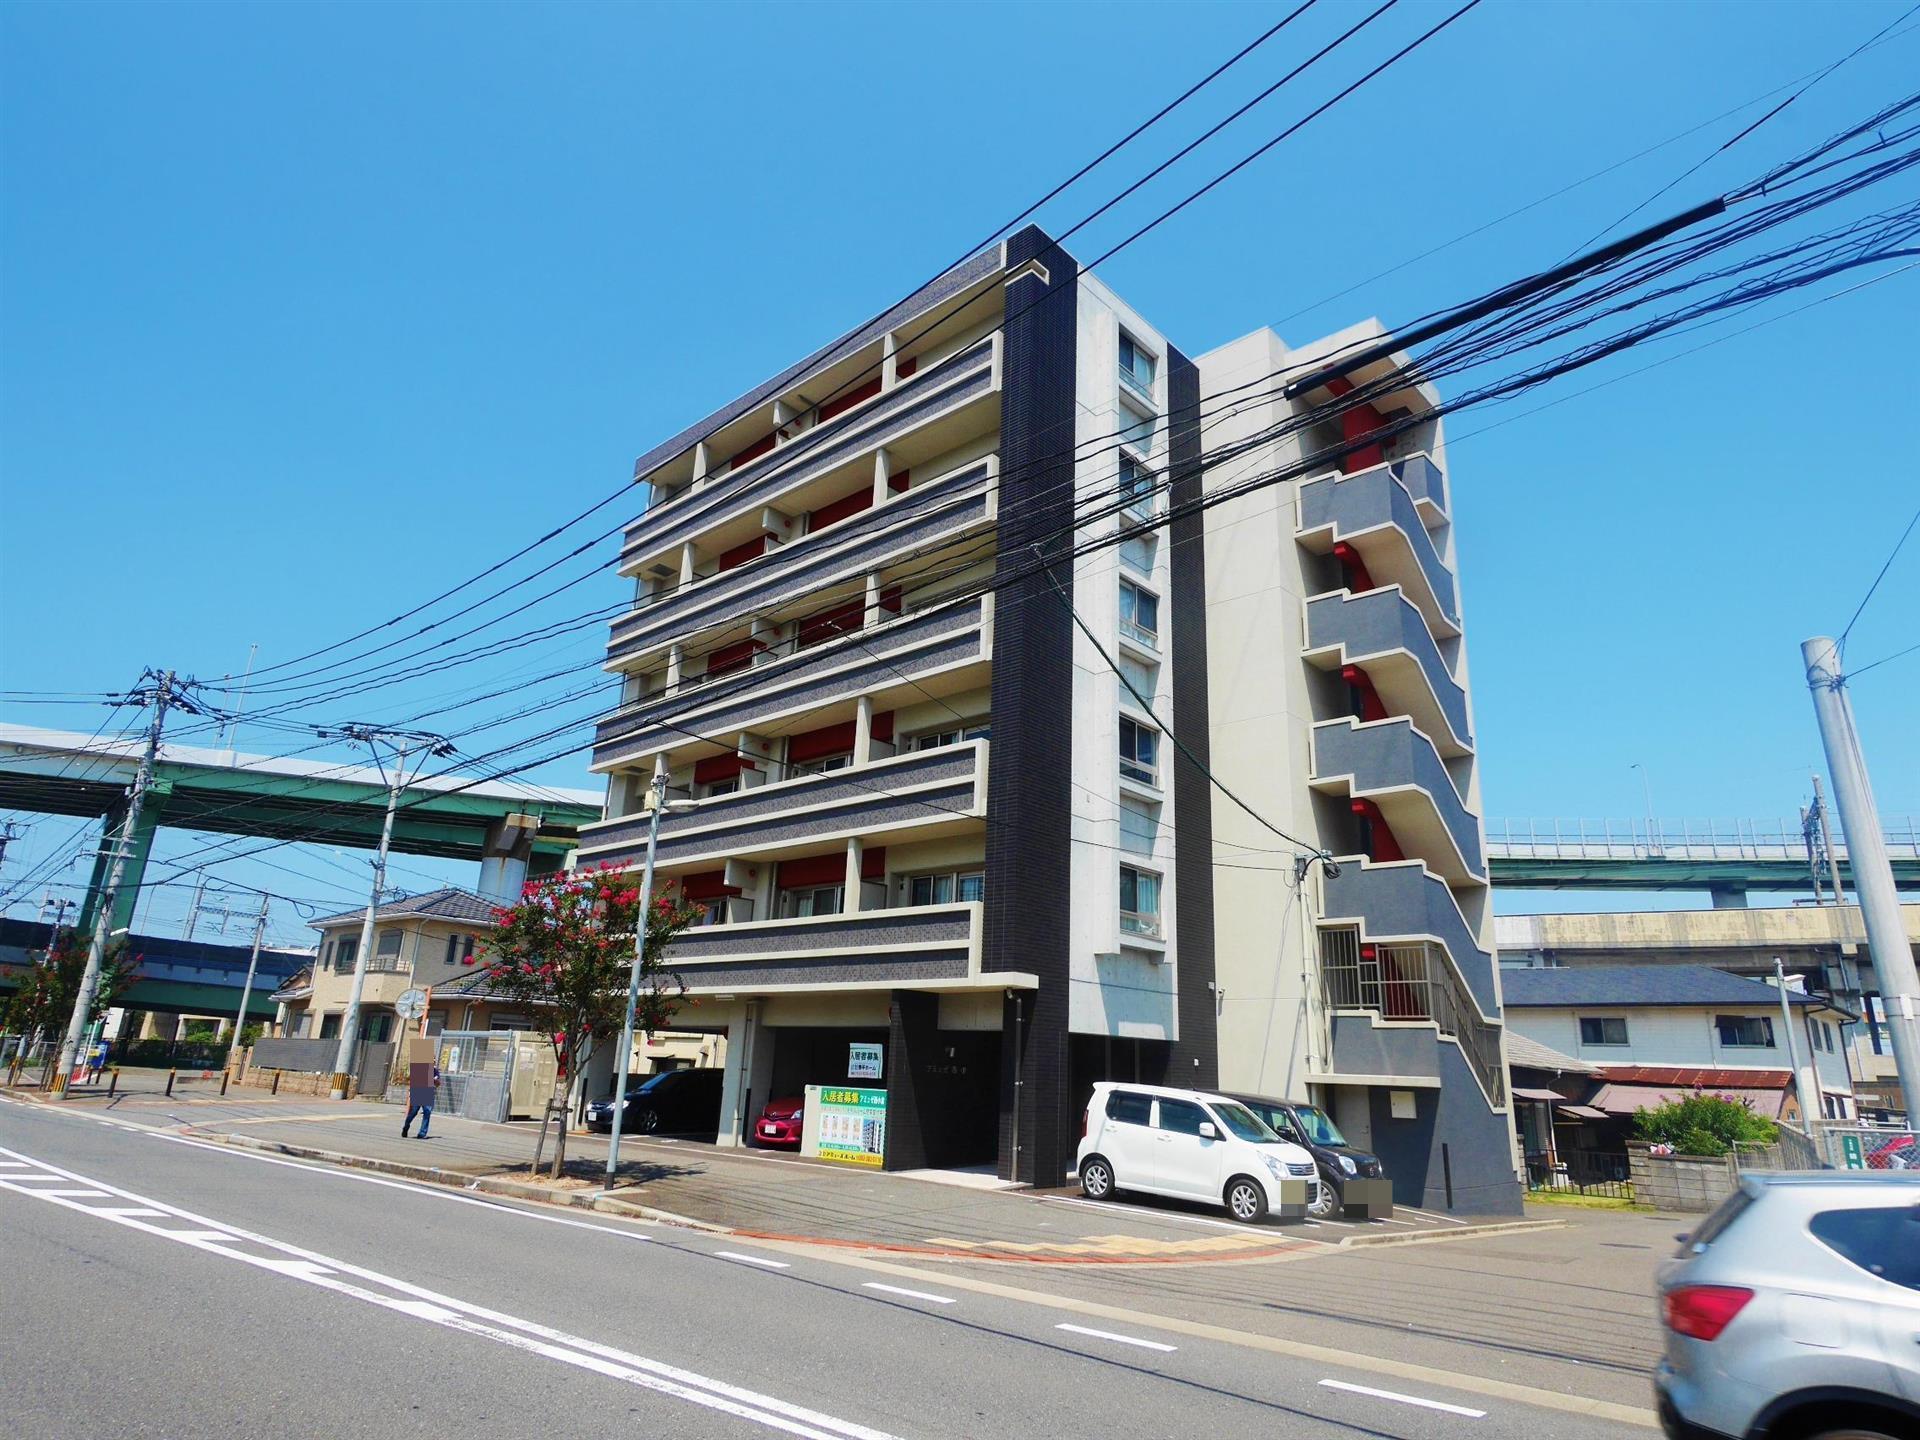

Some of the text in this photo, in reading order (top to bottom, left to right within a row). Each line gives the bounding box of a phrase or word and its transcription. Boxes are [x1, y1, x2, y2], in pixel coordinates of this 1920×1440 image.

[850, 1051, 879, 1061] 入居者募集
[822, 1090, 859, 1104] 入居者募集
